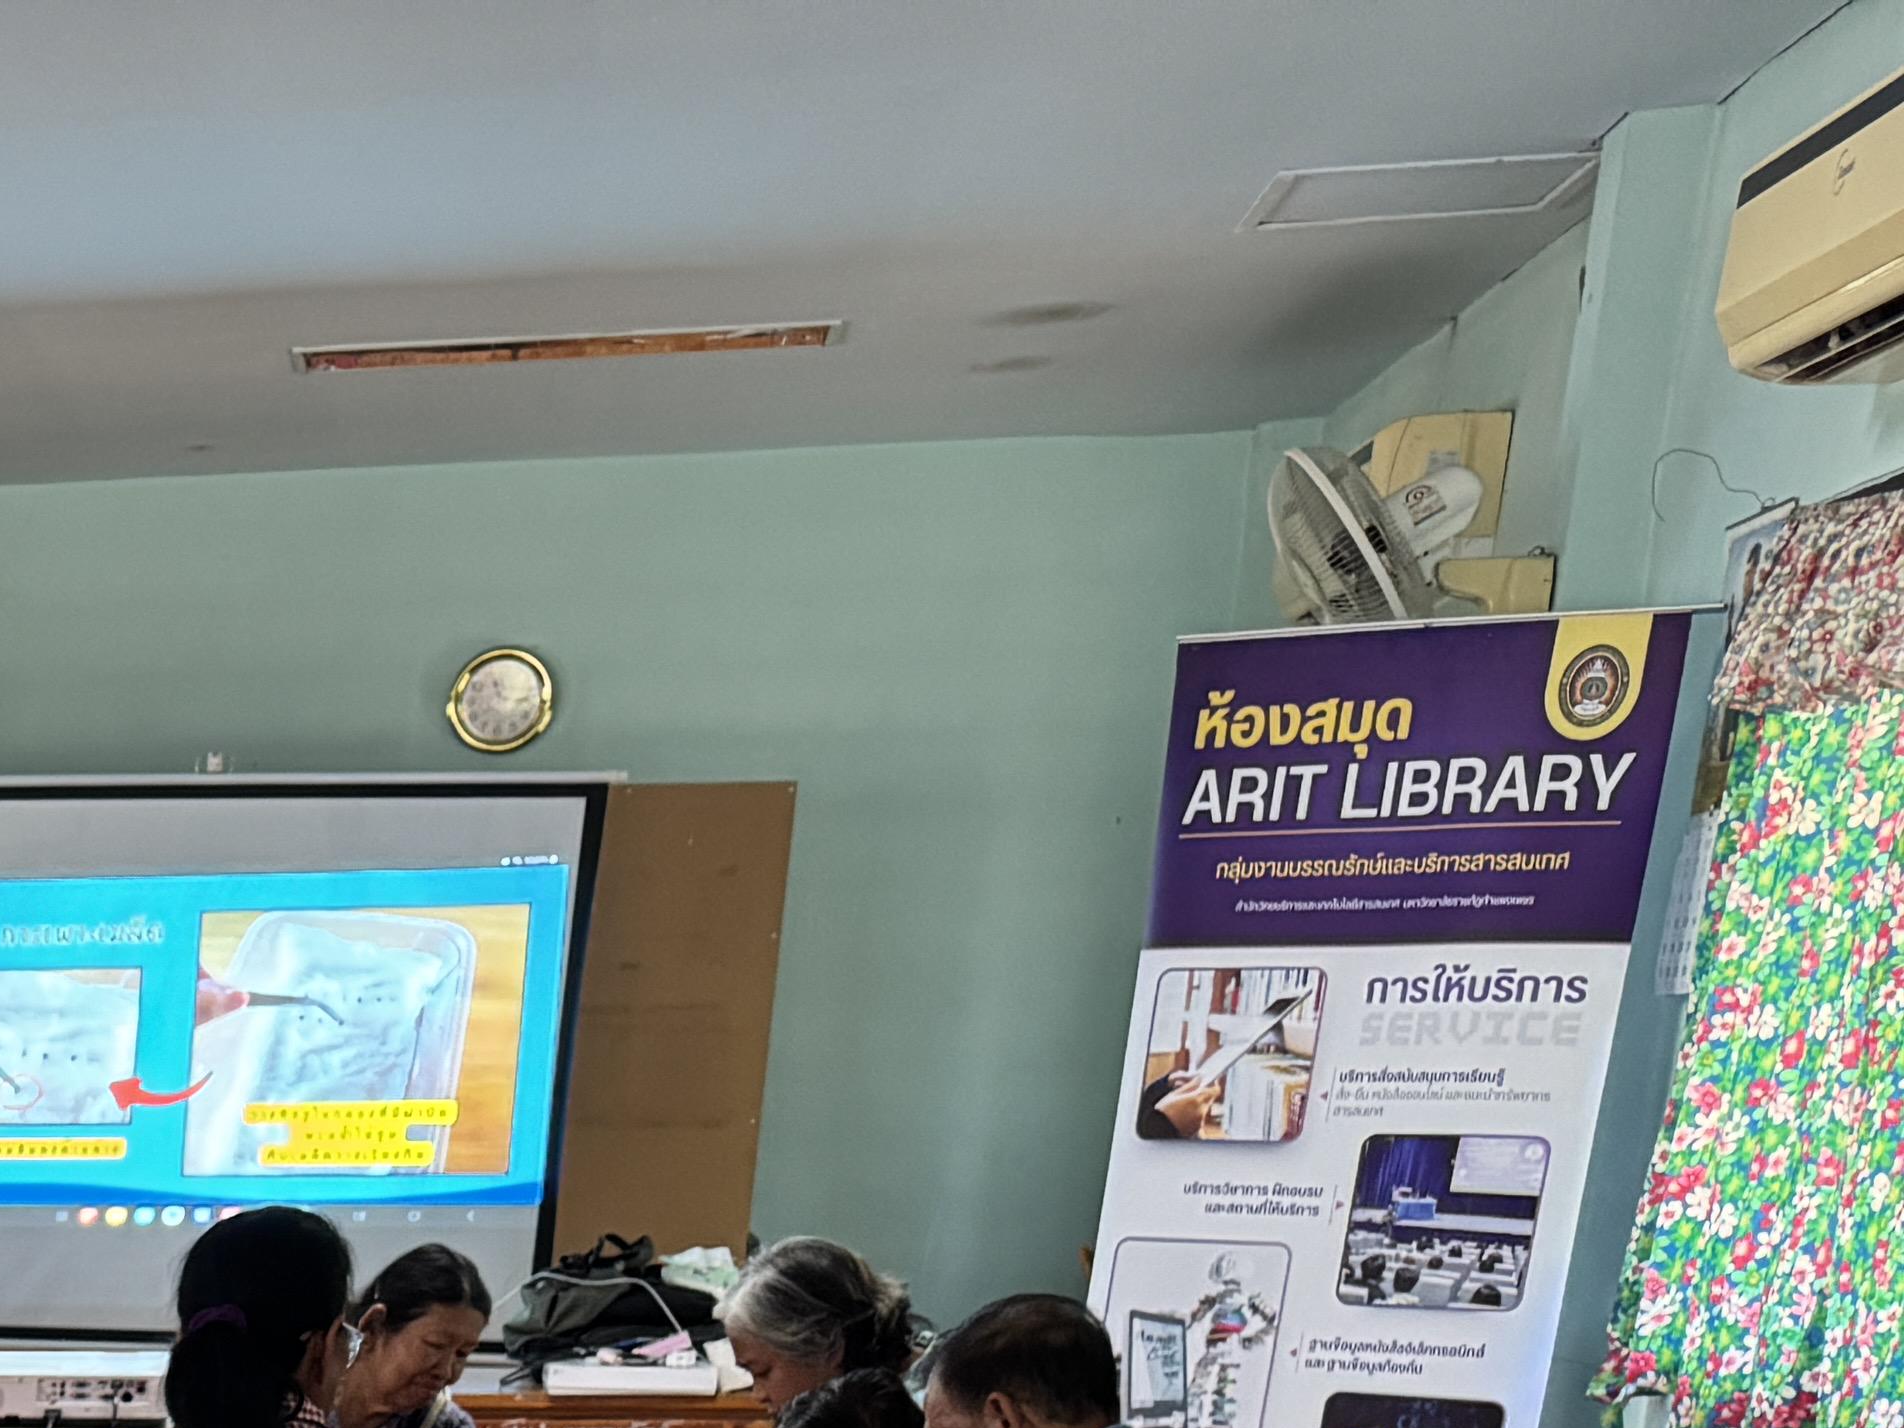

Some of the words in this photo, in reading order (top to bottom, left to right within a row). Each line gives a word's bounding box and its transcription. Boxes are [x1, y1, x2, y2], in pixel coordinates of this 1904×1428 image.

[1194, 690, 1412, 758] ห้องสมุด
[1182, 763, 1327, 825] ARIT
[1340, 752, 1636, 819] LIBRARY
[1215, 851, 1571, 884] กลุ่มงานบรรณรักษ์และบริการสารสนเทศ
[1365, 963, 1589, 1004] การให้บริการ
[1359, 1010, 1584, 1047] SERVICE
